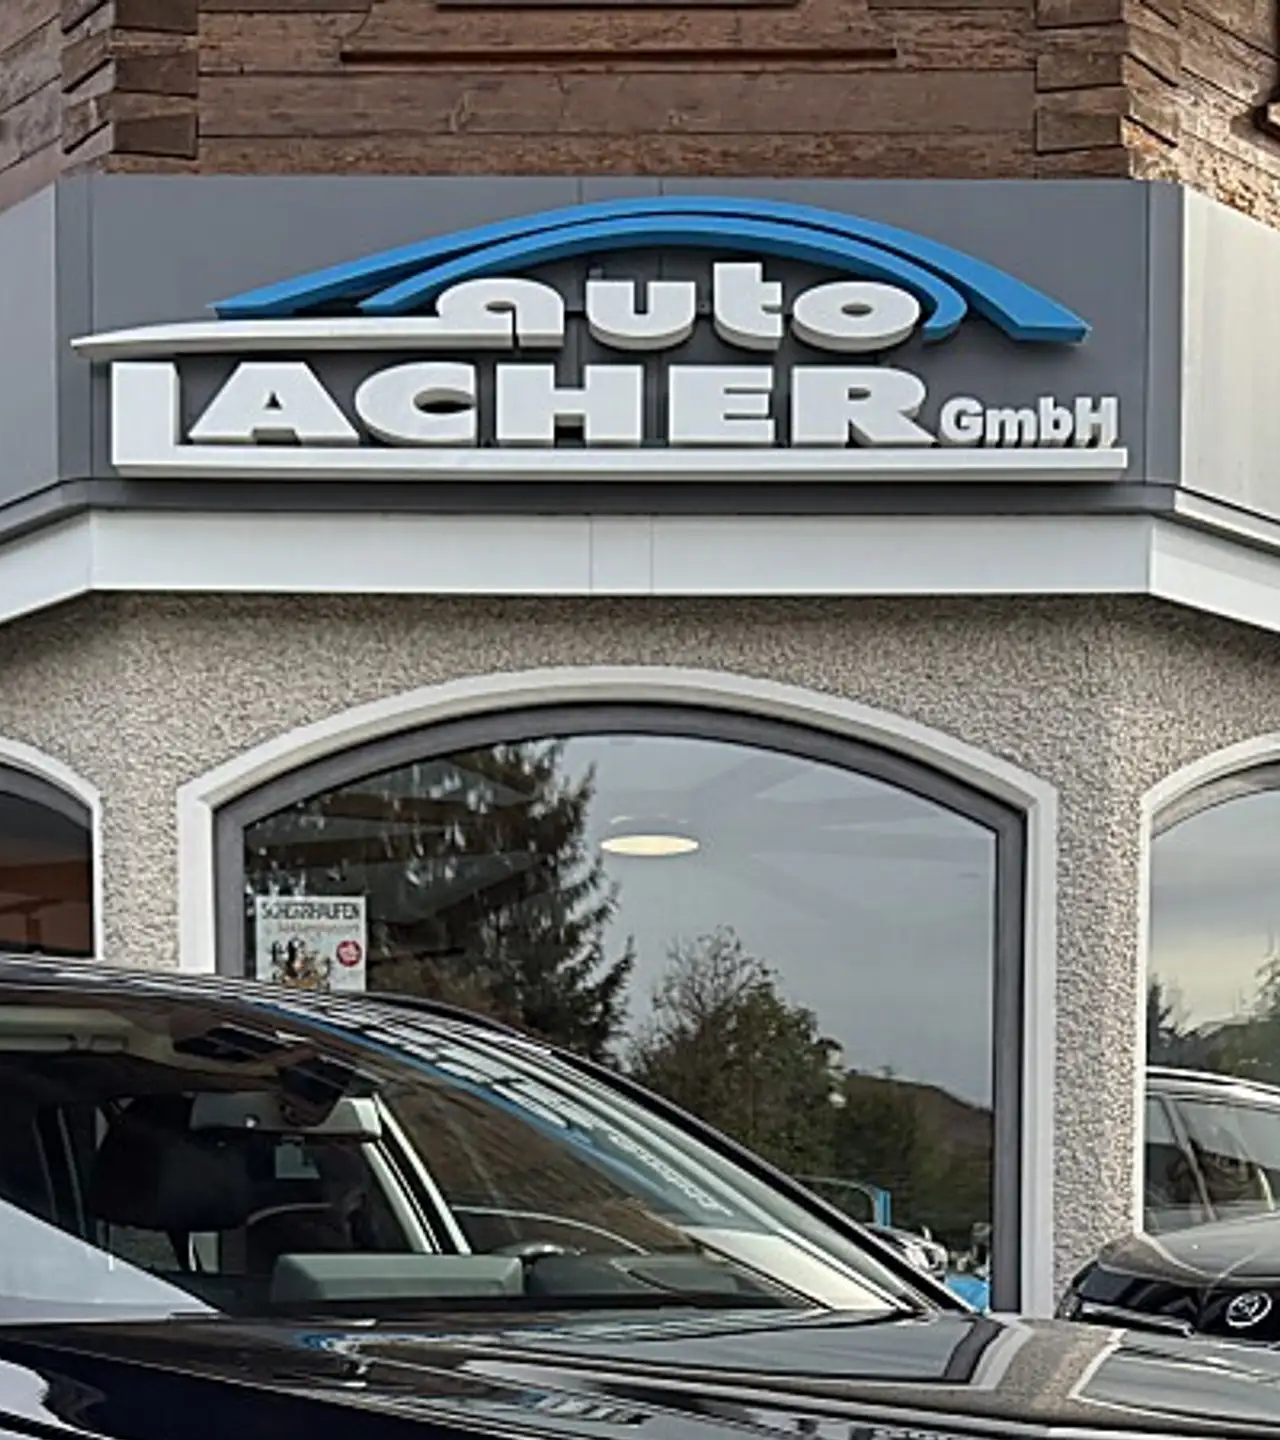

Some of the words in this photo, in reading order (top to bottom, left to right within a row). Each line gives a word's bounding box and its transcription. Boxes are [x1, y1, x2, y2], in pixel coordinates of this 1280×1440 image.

[434, 262, 921, 353] auto
[110, 360, 940, 478] LACHER
[939, 396, 1120, 448] GmbH
